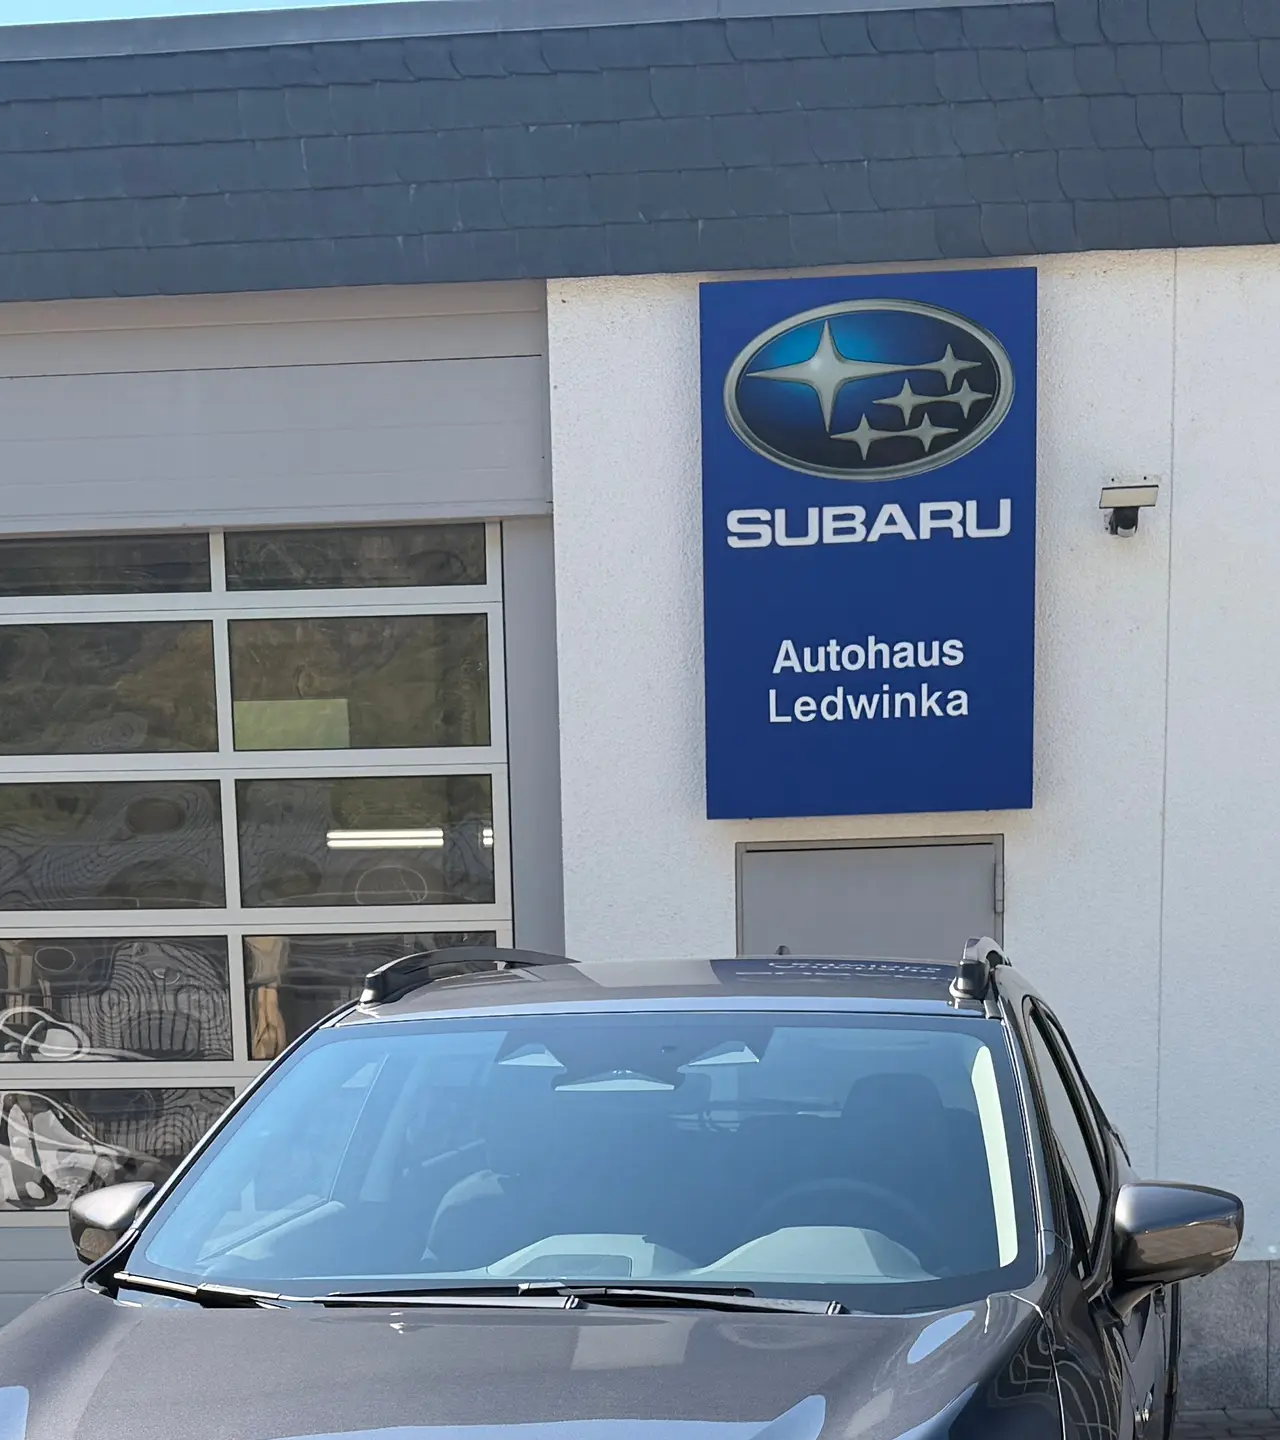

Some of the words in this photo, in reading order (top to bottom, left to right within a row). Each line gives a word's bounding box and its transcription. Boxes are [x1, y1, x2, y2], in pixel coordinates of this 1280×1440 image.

[726, 498, 1012, 548] SUBARU
[772, 635, 965, 675] Autohaus
[768, 683, 970, 723] Ledwinka
